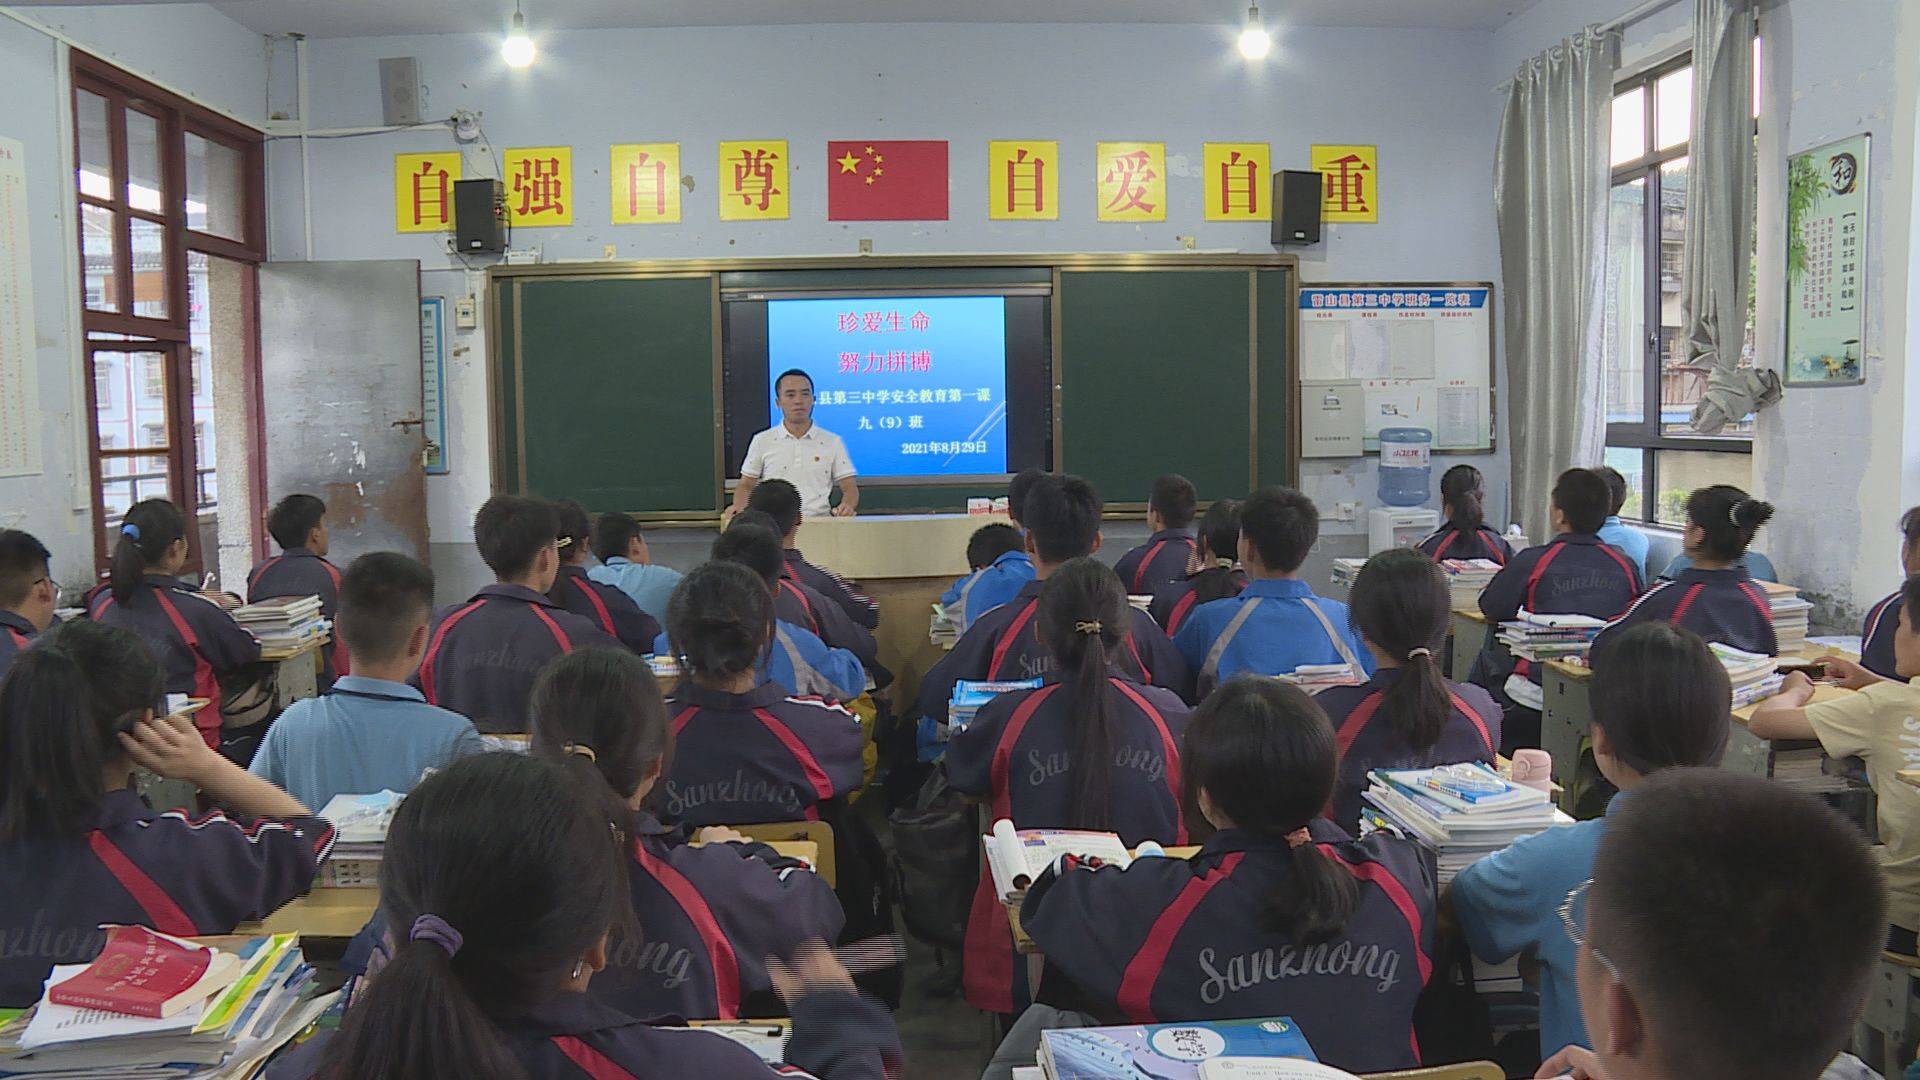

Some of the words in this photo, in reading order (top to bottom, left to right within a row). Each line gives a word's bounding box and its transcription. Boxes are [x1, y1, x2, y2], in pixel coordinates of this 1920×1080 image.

[1833, 160, 1852, 186] 和
[413, 161, 449, 225] 自
[512, 157, 564, 216] 强
[629, 152, 666, 216] 自
[727, 149, 781, 211] 尊
[1007, 149, 1045, 212] 自
[1105, 150, 1157, 213] 爱
[1221, 151, 1257, 214] 自
[1319, 154, 1371, 212] 重
[838, 310, 930, 333] 珍爱生命
[838, 350, 933, 375] 努力拼搏
[814, 387, 992, 405] 县第三中学安全教育第一课
[901, 441, 988, 455] 2021年8月29日
